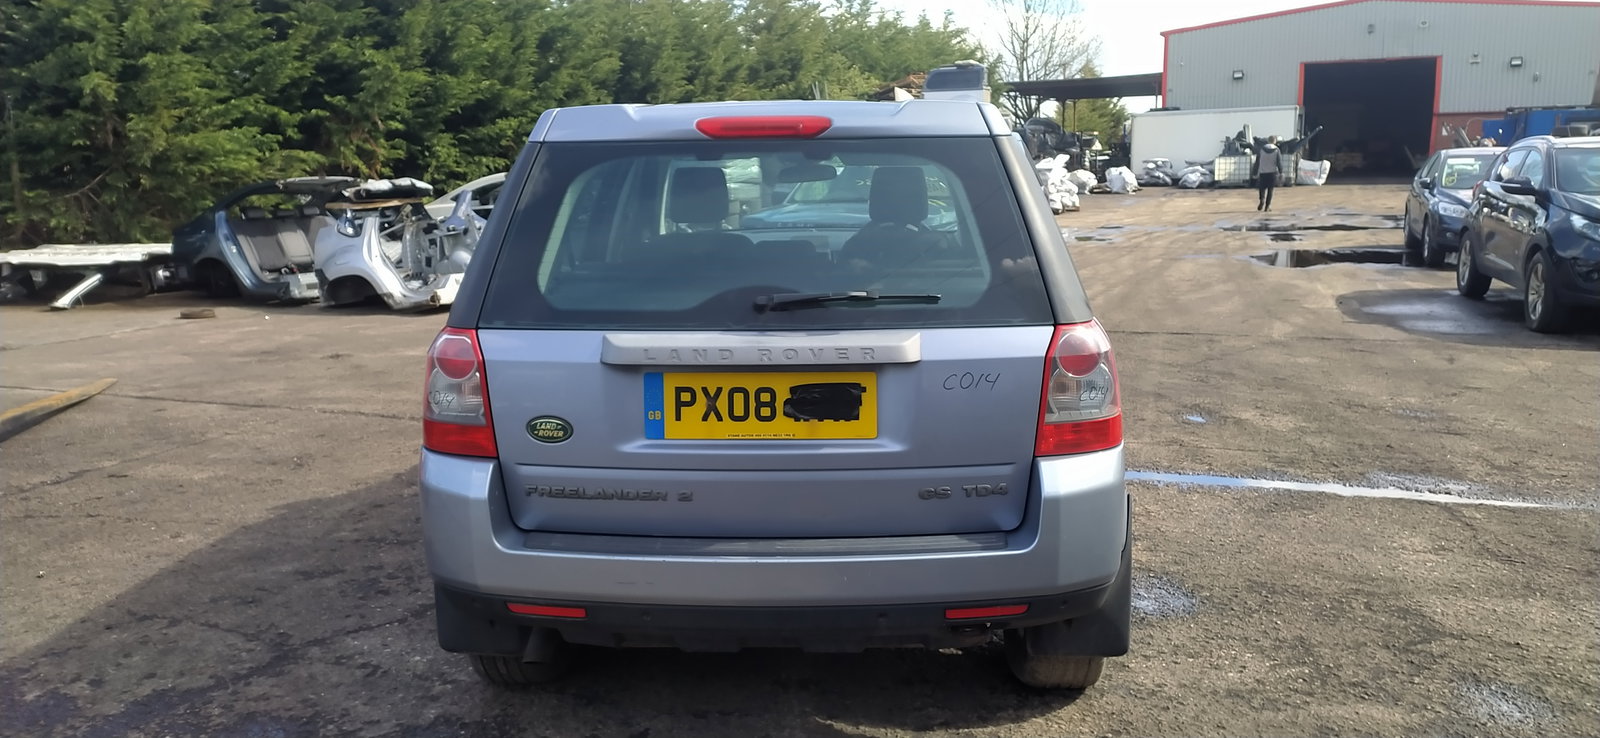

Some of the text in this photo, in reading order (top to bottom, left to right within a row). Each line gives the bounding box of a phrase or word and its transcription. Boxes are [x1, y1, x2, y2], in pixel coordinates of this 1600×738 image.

[643, 348, 876, 361] LAND ROVER
[674, 386, 777, 422] PX08
[648, 411, 662, 420] GB
[536, 422, 557, 430] LAND
[525, 485, 694, 502] FREELANDER 2
[918, 483, 1008, 500] GS TD4
